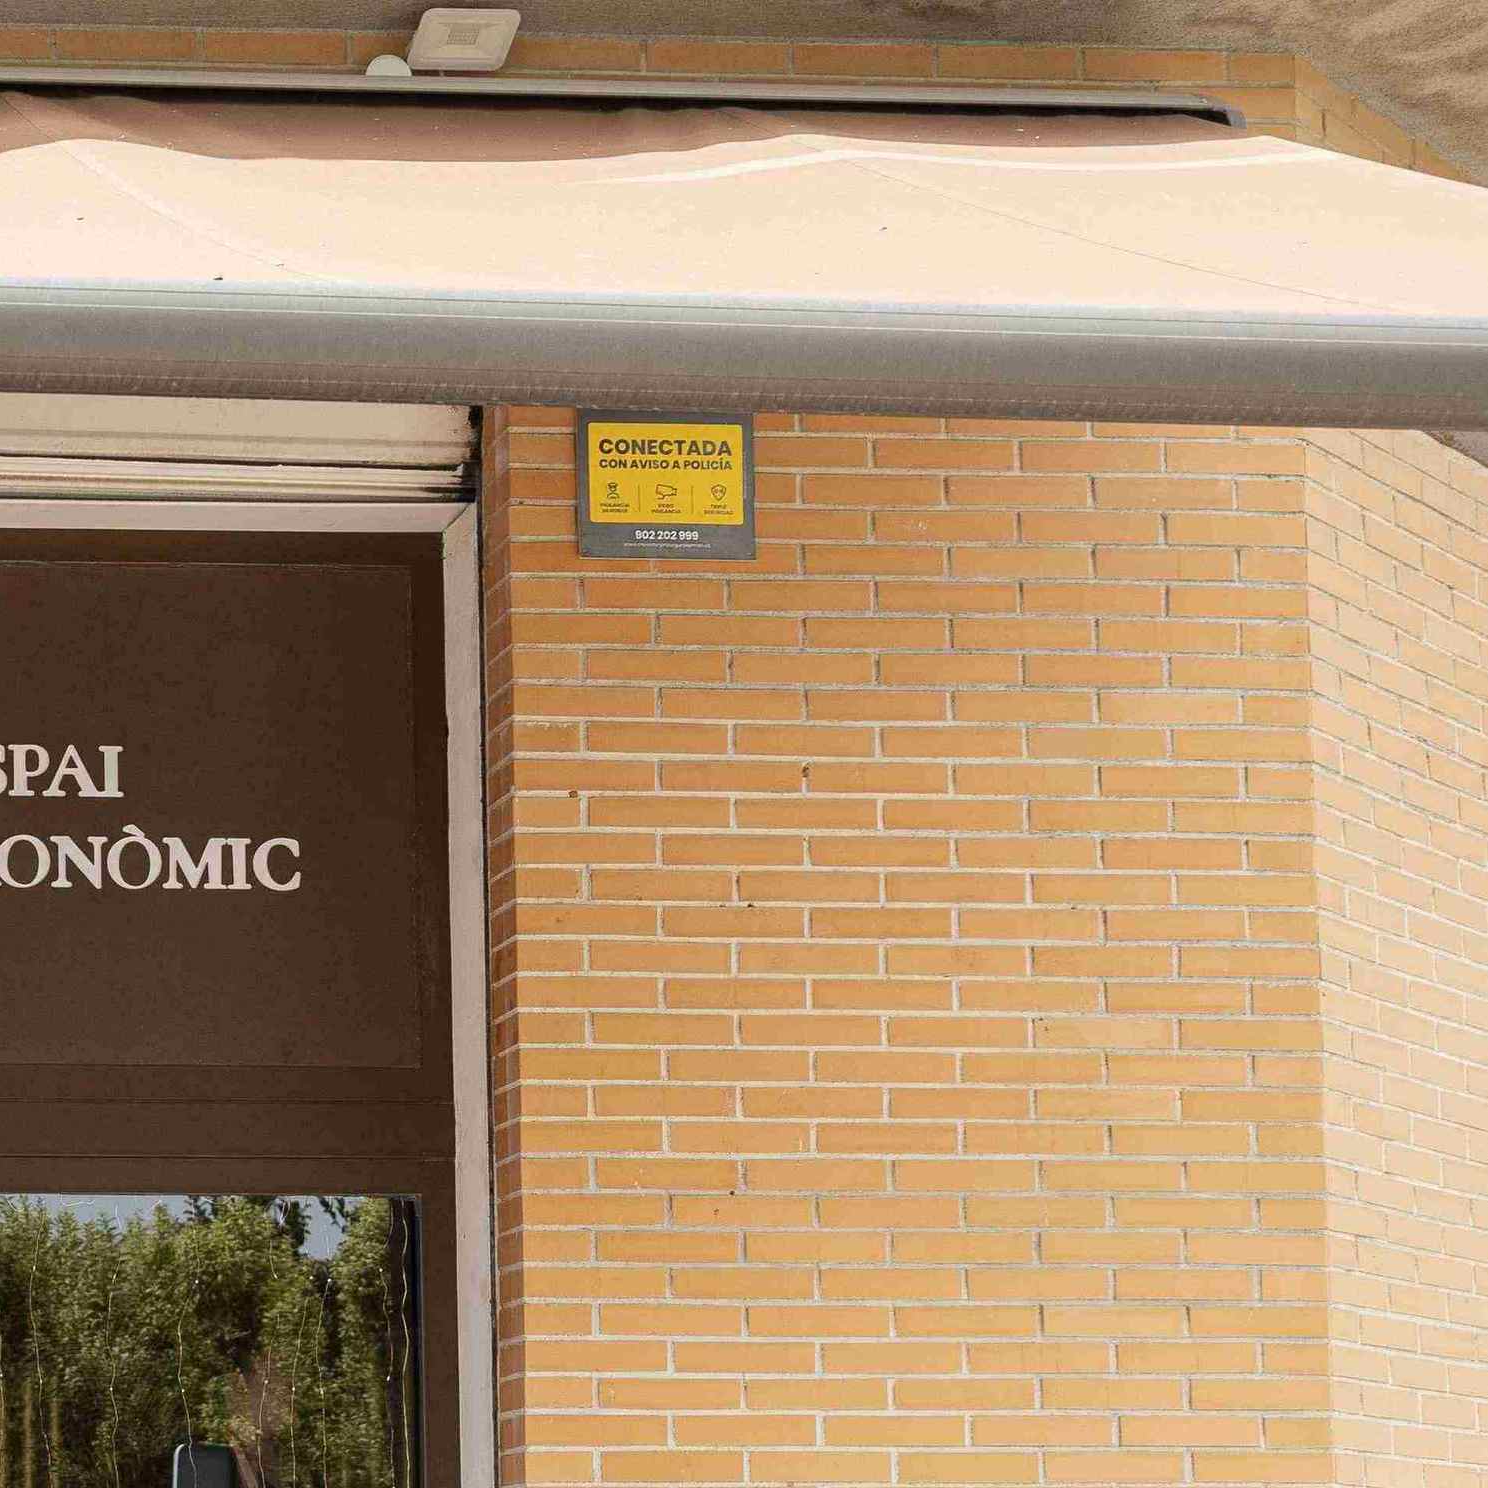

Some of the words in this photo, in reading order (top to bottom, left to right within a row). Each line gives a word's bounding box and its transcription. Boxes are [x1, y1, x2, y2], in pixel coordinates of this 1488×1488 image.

[598, 438, 733, 457] CONECTADA
[598, 459, 628, 469] CON
[630, 459, 670, 470] AVISO
[672, 460, 681, 470] A
[683, 458, 733, 470] POLICÍA
[657, 530, 678, 540] 202
